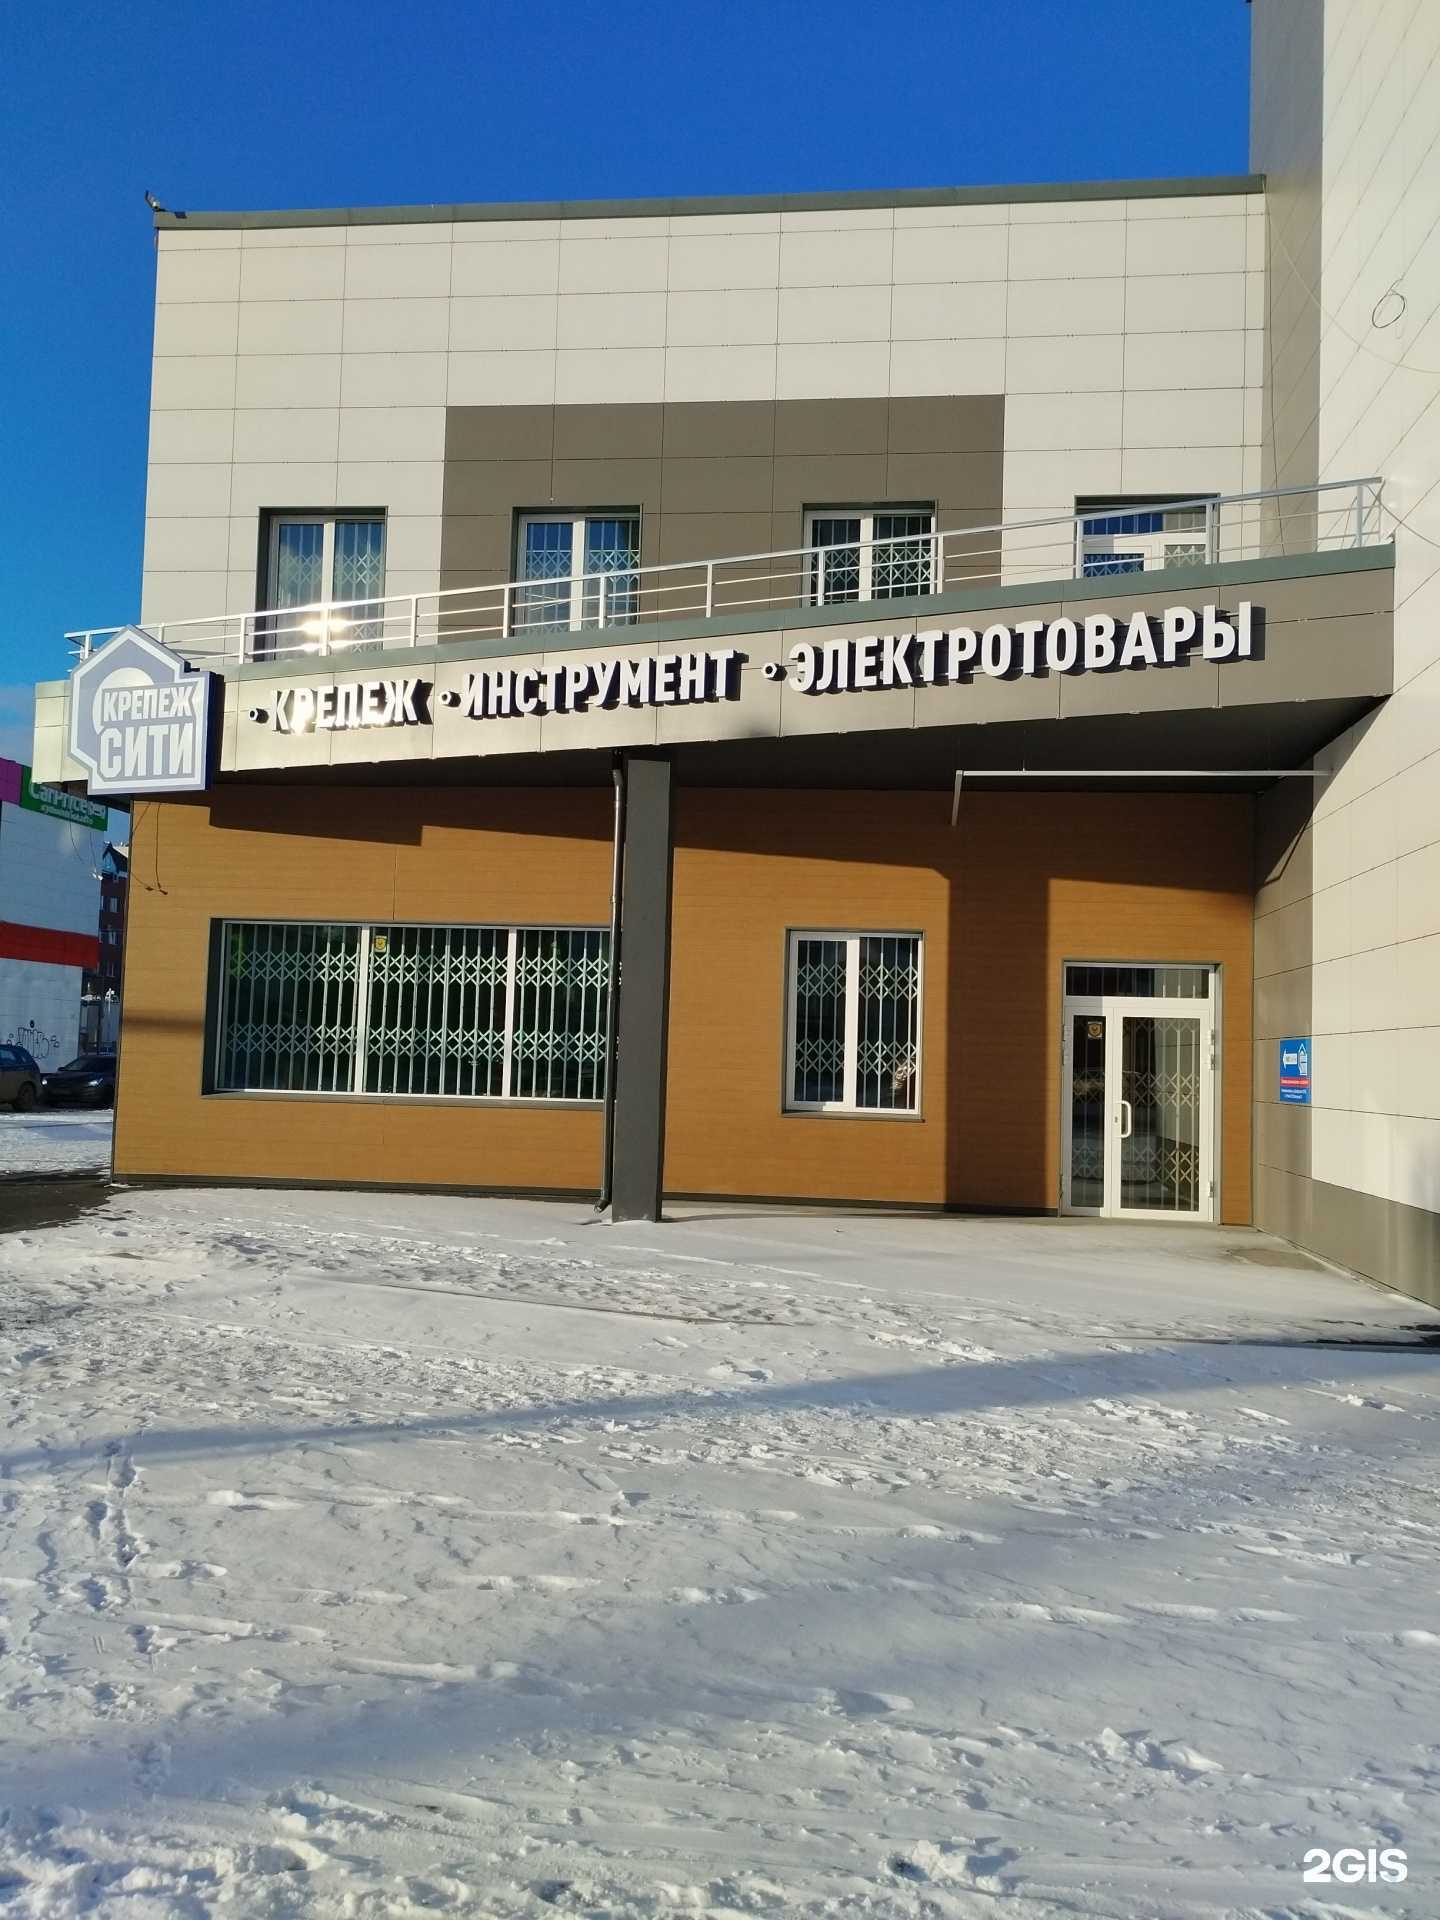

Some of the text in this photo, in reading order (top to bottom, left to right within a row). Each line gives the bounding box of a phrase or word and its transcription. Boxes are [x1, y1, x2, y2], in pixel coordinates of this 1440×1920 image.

[269, 601, 1254, 733] КРЕПЕЖ ИНСТРУМЕНТ ЭЛЕКТРОТОВАРЫ
[104, 686, 193, 721] КРЕПЕЖ
[99, 723, 193, 778] СИТИ
